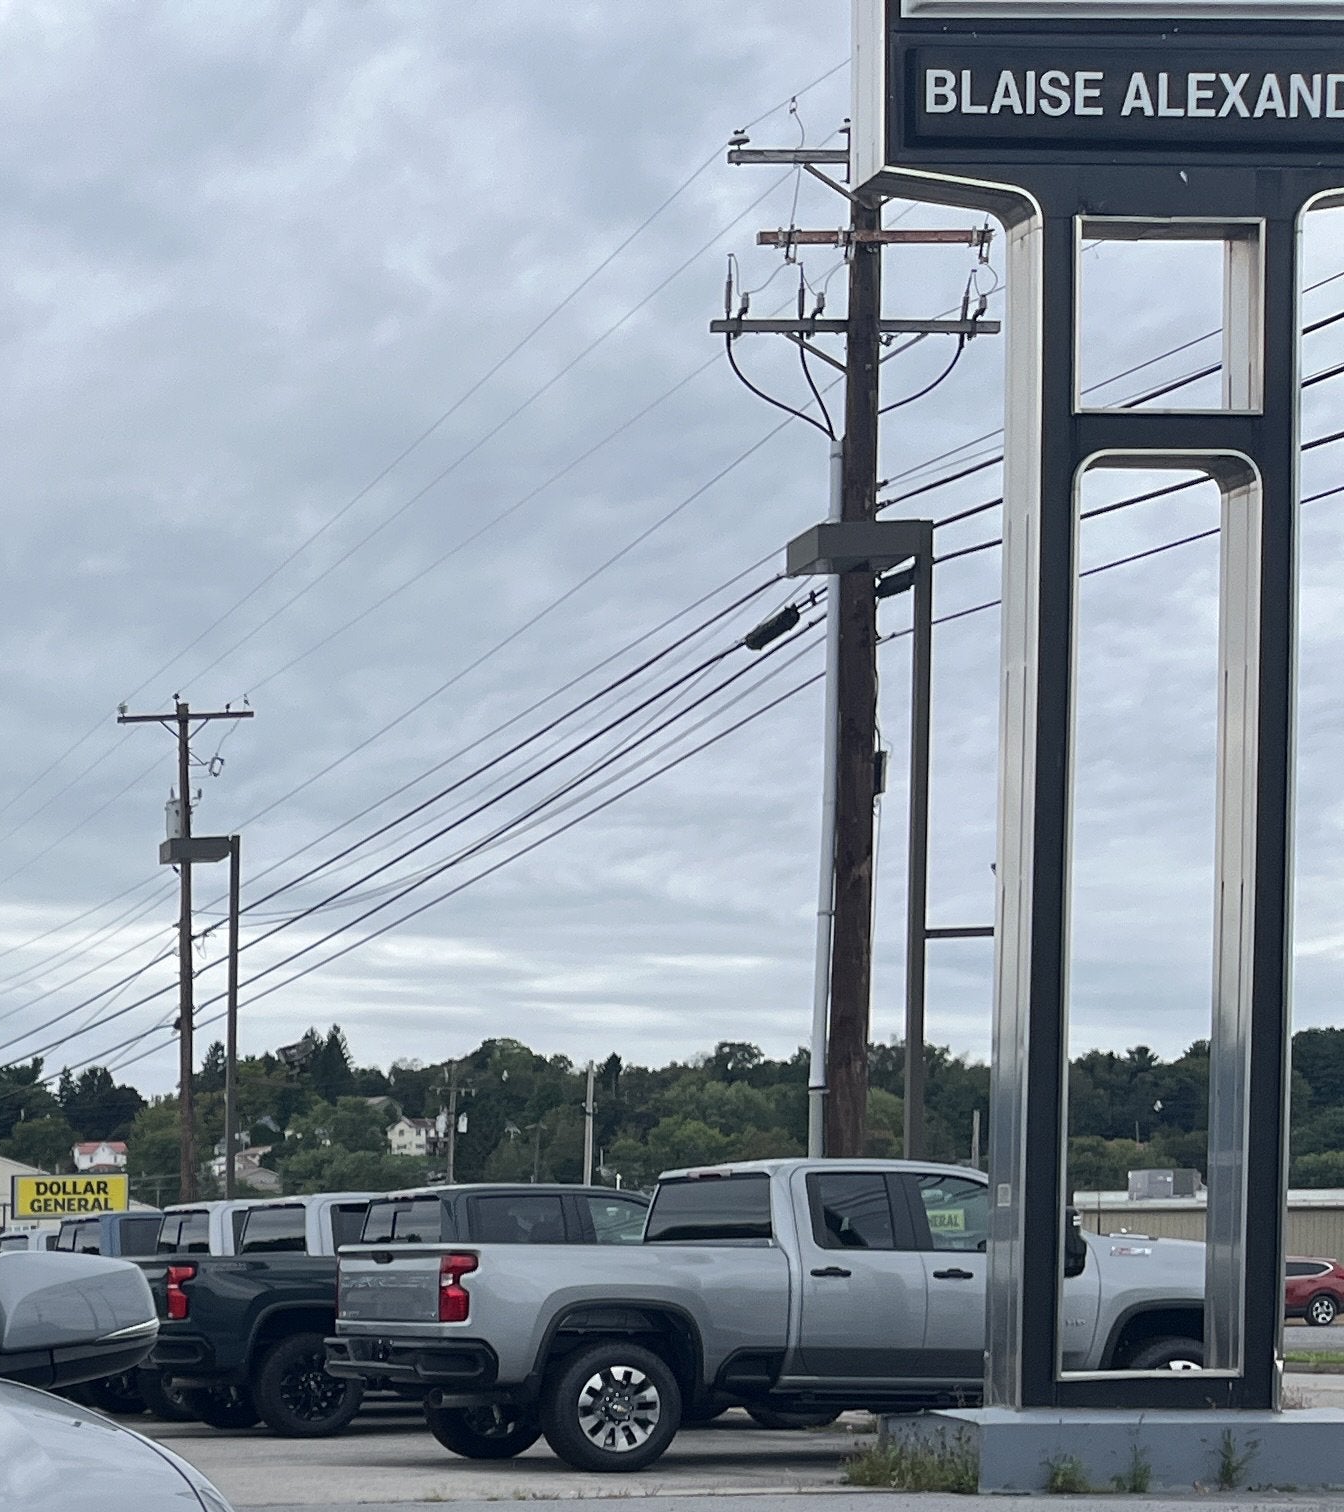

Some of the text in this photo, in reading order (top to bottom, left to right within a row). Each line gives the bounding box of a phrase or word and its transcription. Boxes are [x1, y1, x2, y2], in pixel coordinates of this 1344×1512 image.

[925, 69, 1104, 117] BLAISE
[35, 1181, 109, 1196] DOLLAR
[30, 1198, 114, 1213] GENERAL
